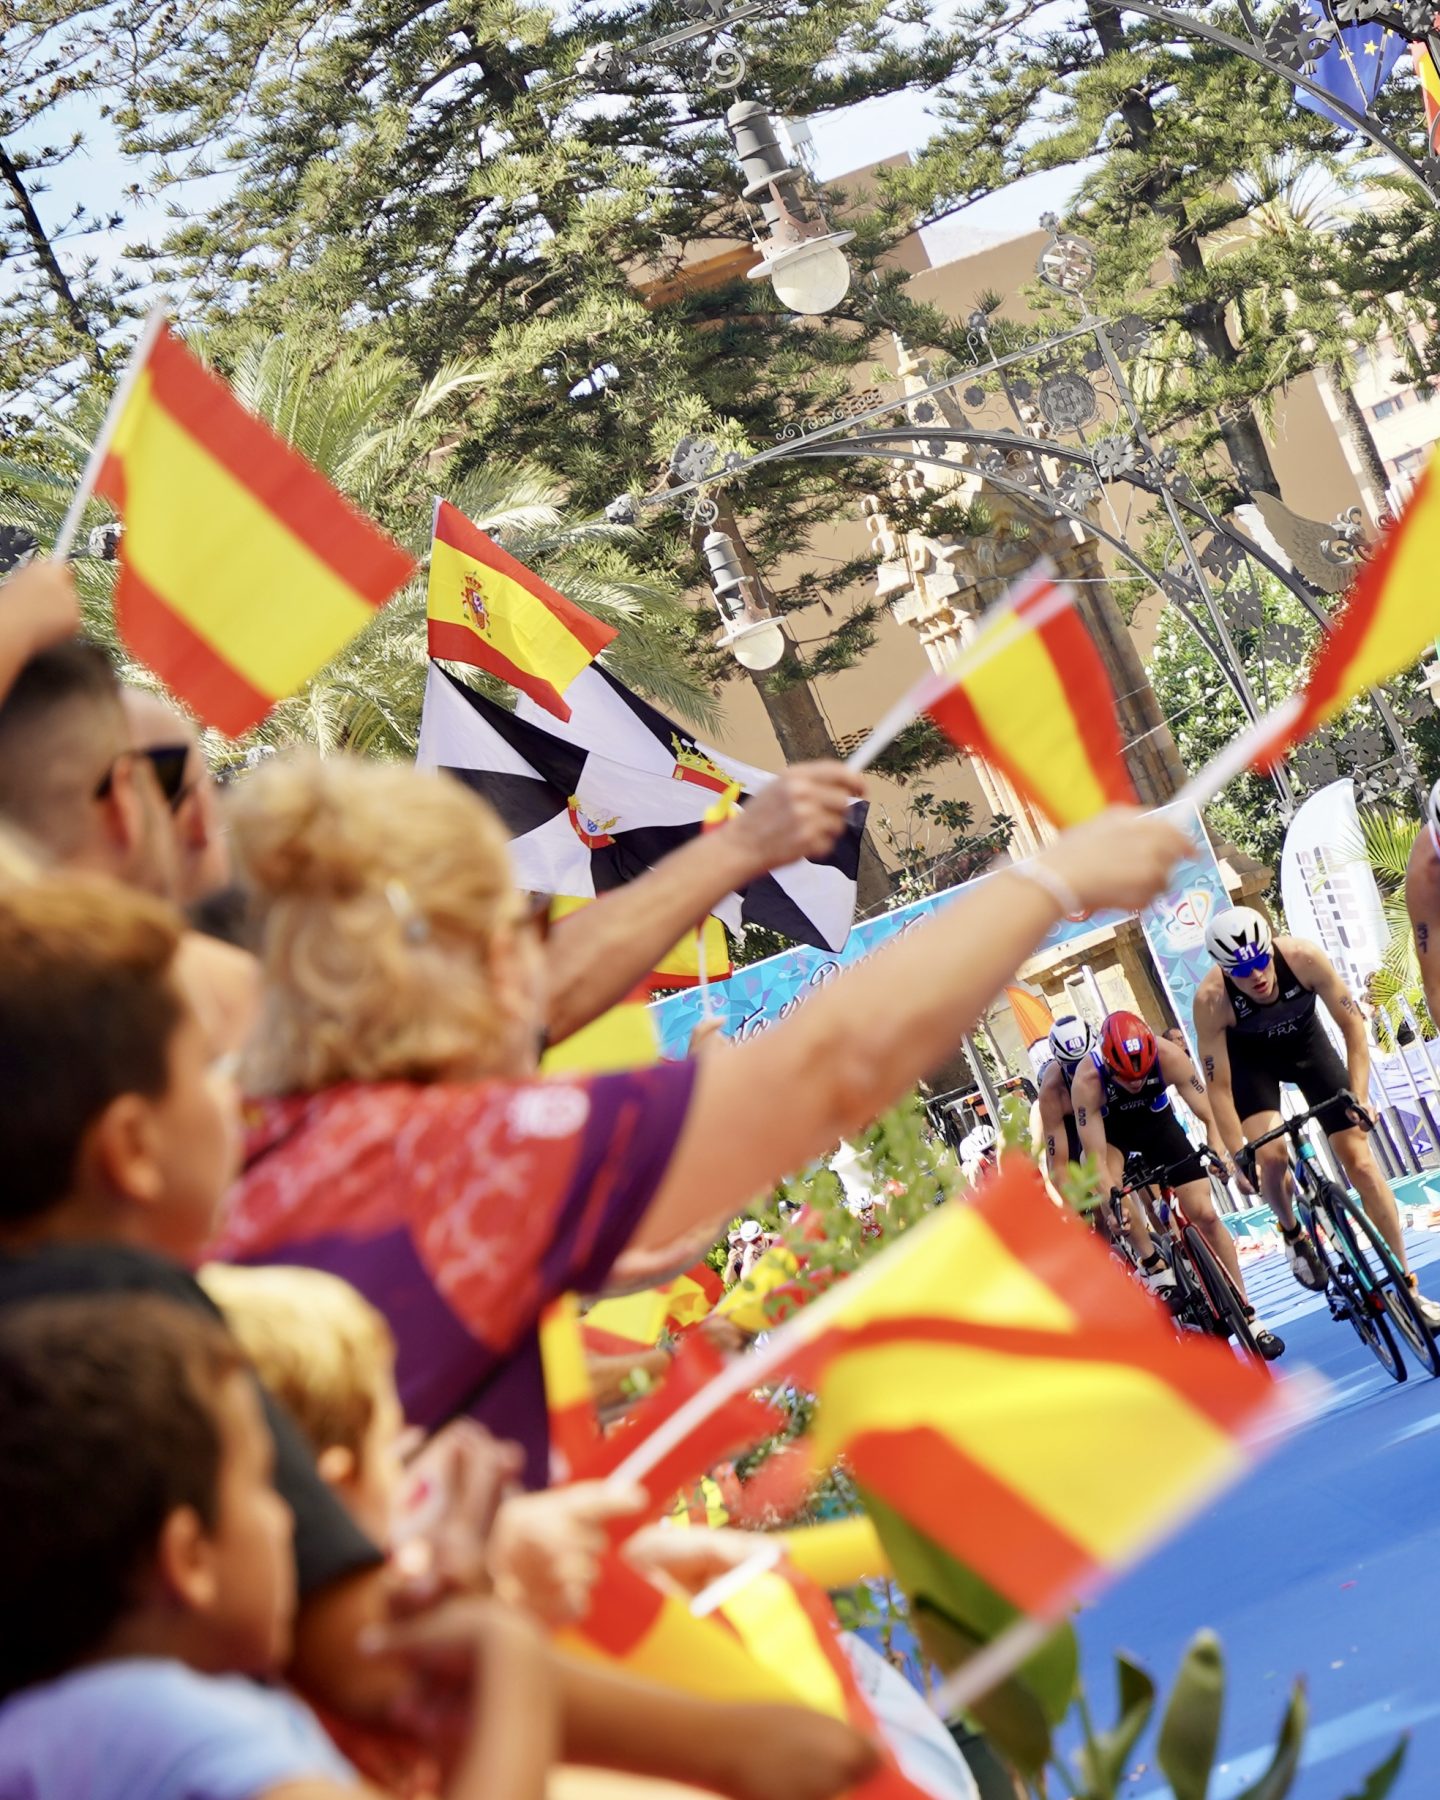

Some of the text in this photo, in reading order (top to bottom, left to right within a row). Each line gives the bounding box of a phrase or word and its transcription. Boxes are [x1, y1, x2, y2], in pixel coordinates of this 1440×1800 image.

[1239, 944, 1256, 961] 51
[1267, 1022, 1298, 1039] FRA
[1069, 1038, 1081, 1050] 40
[1125, 1040, 1141, 1052] 59
